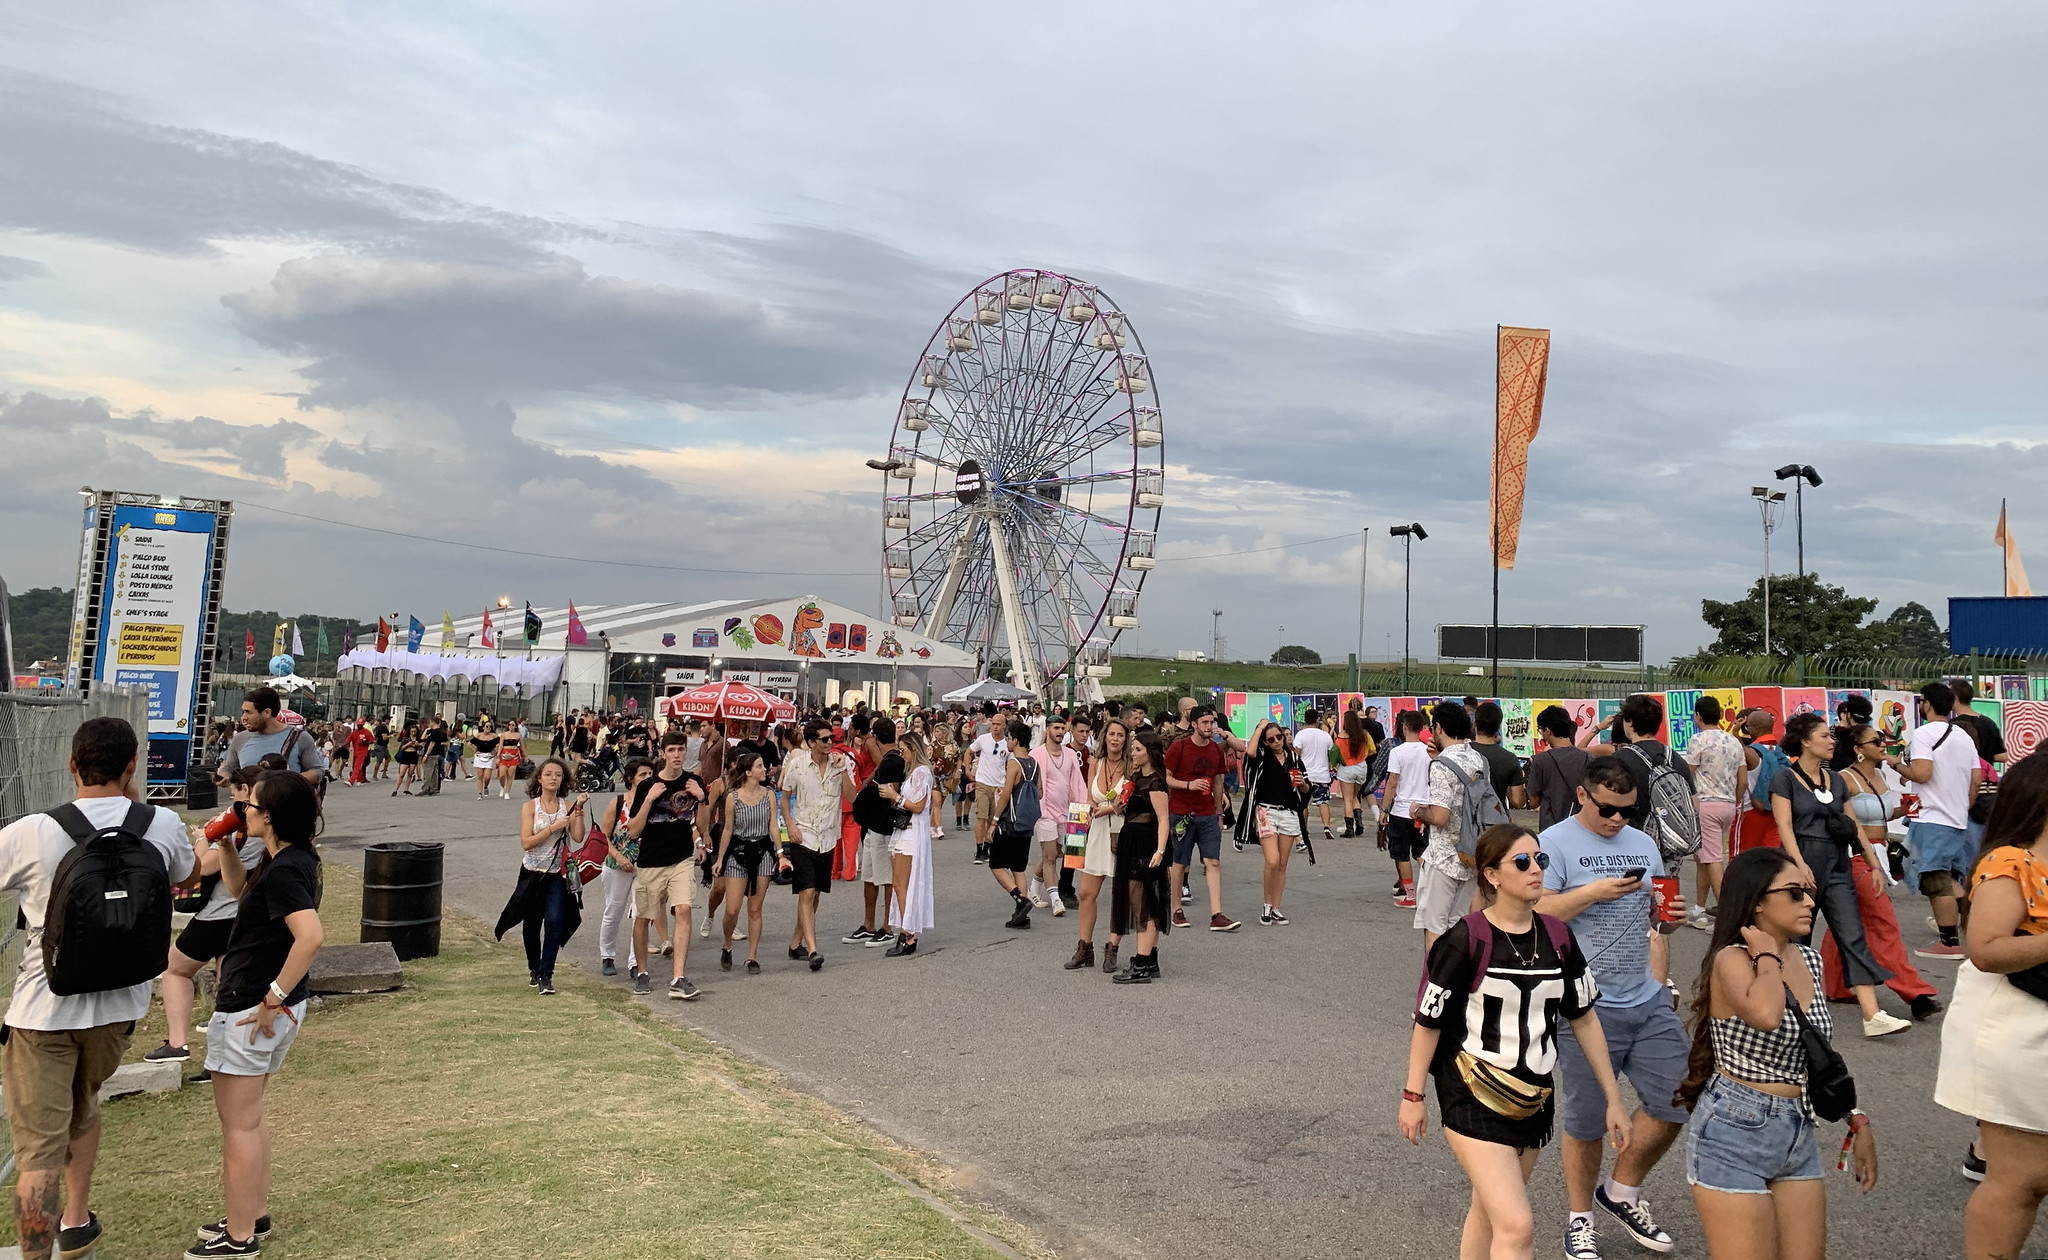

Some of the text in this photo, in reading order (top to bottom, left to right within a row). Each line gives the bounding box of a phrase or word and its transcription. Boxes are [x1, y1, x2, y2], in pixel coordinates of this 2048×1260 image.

[676, 671, 694, 680] SAÍDA
[682, 702, 710, 711] KIBON
[729, 705, 760, 716] KIBON
[775, 709, 792, 717] KIBON
[1606, 855, 1650, 866] DISTRICTS
